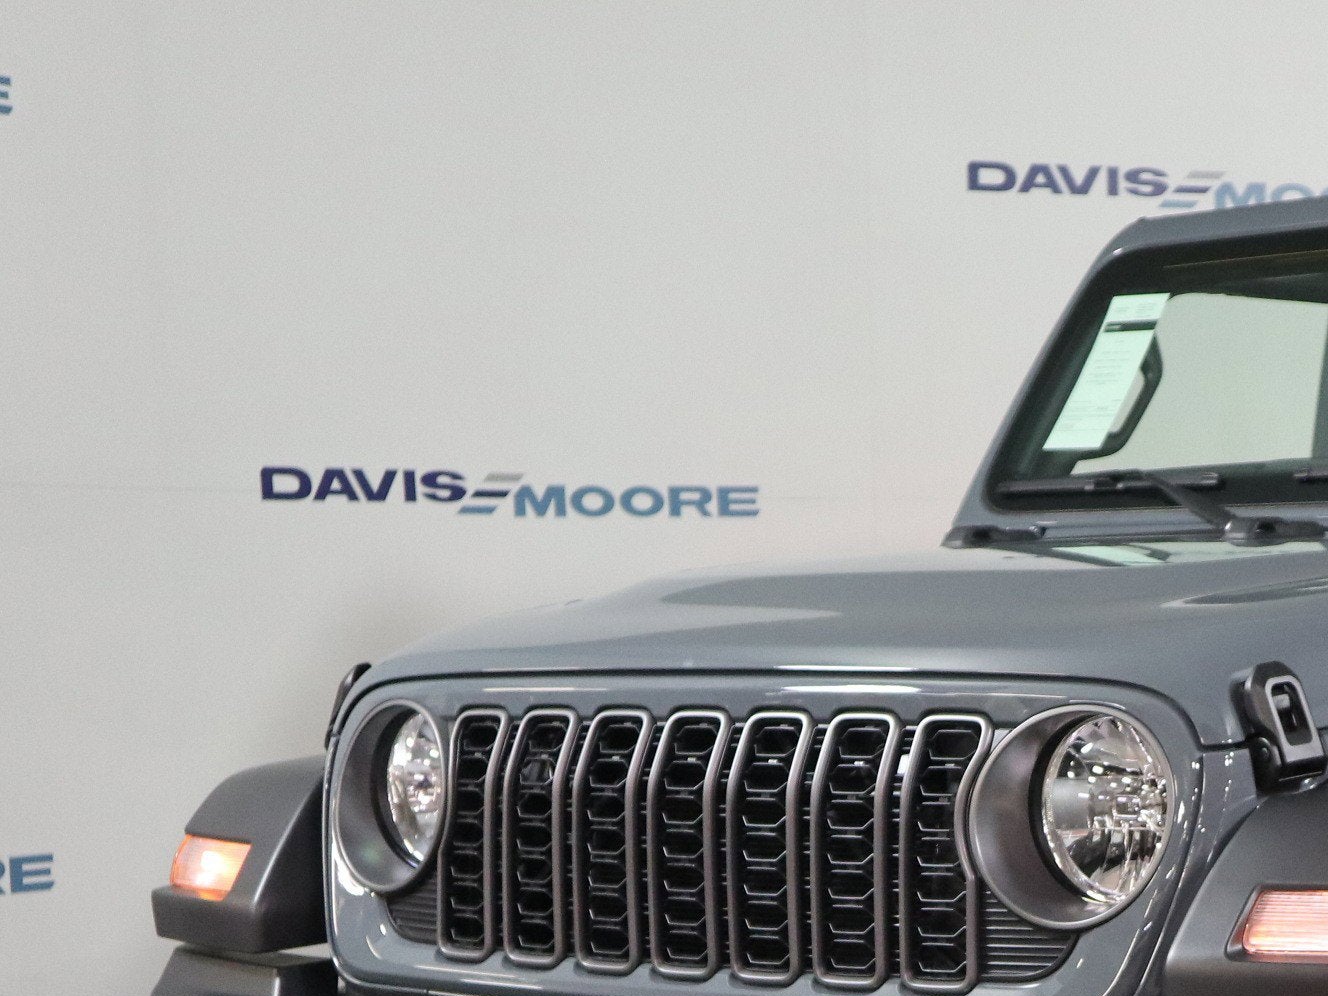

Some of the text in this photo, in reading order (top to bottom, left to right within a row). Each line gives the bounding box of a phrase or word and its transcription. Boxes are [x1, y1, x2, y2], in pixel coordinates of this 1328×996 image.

[966, 160, 1170, 198] DAVIS
[259, 465, 760, 518] DAVIS MOORE
